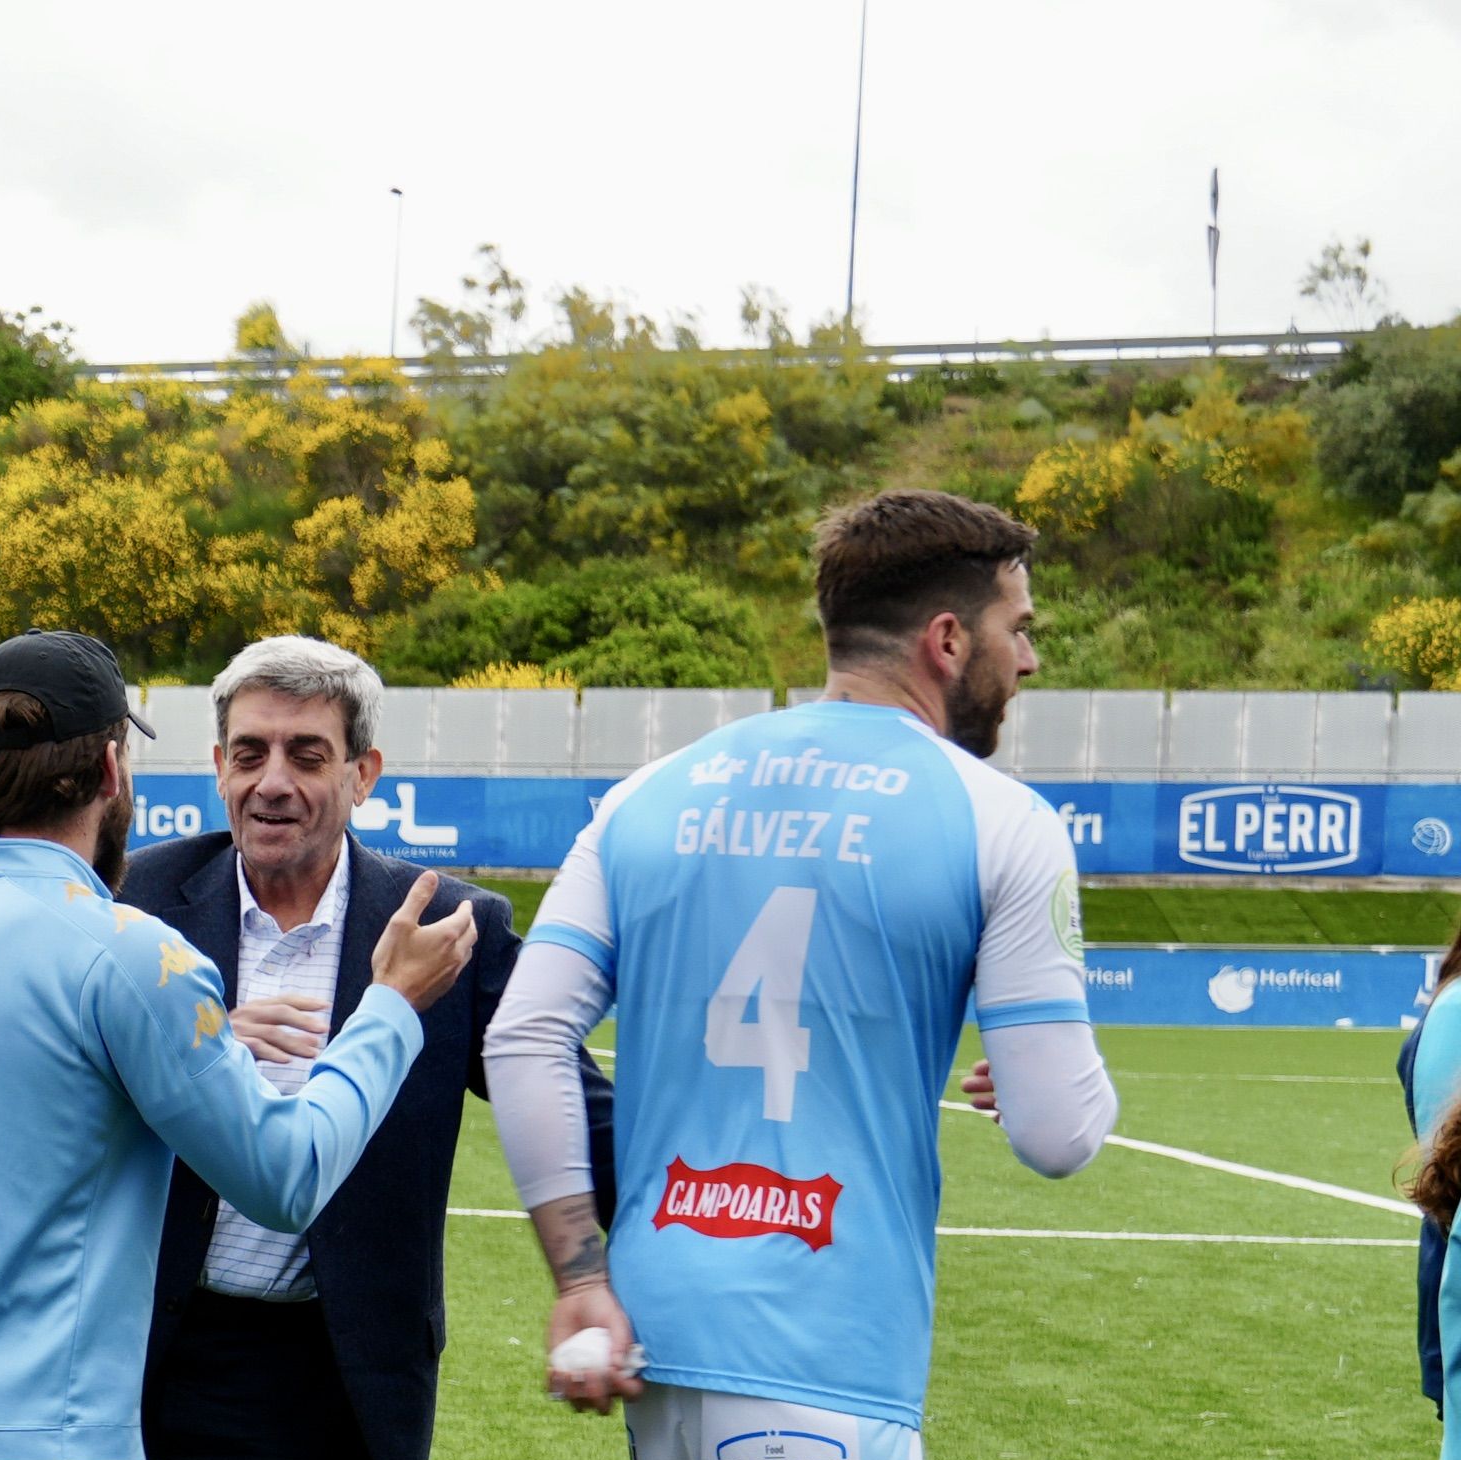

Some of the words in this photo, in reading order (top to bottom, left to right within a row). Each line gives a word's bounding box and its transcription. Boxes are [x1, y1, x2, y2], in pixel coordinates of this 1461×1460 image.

[751, 748, 909, 796] Infrico
[677, 797, 830, 858] GÁLVEZ
[837, 815, 873, 864] E.
[1179, 803, 1226, 852] EL
[704, 886, 817, 1122] 4
[665, 1180, 823, 1231] CAMPOARAS
